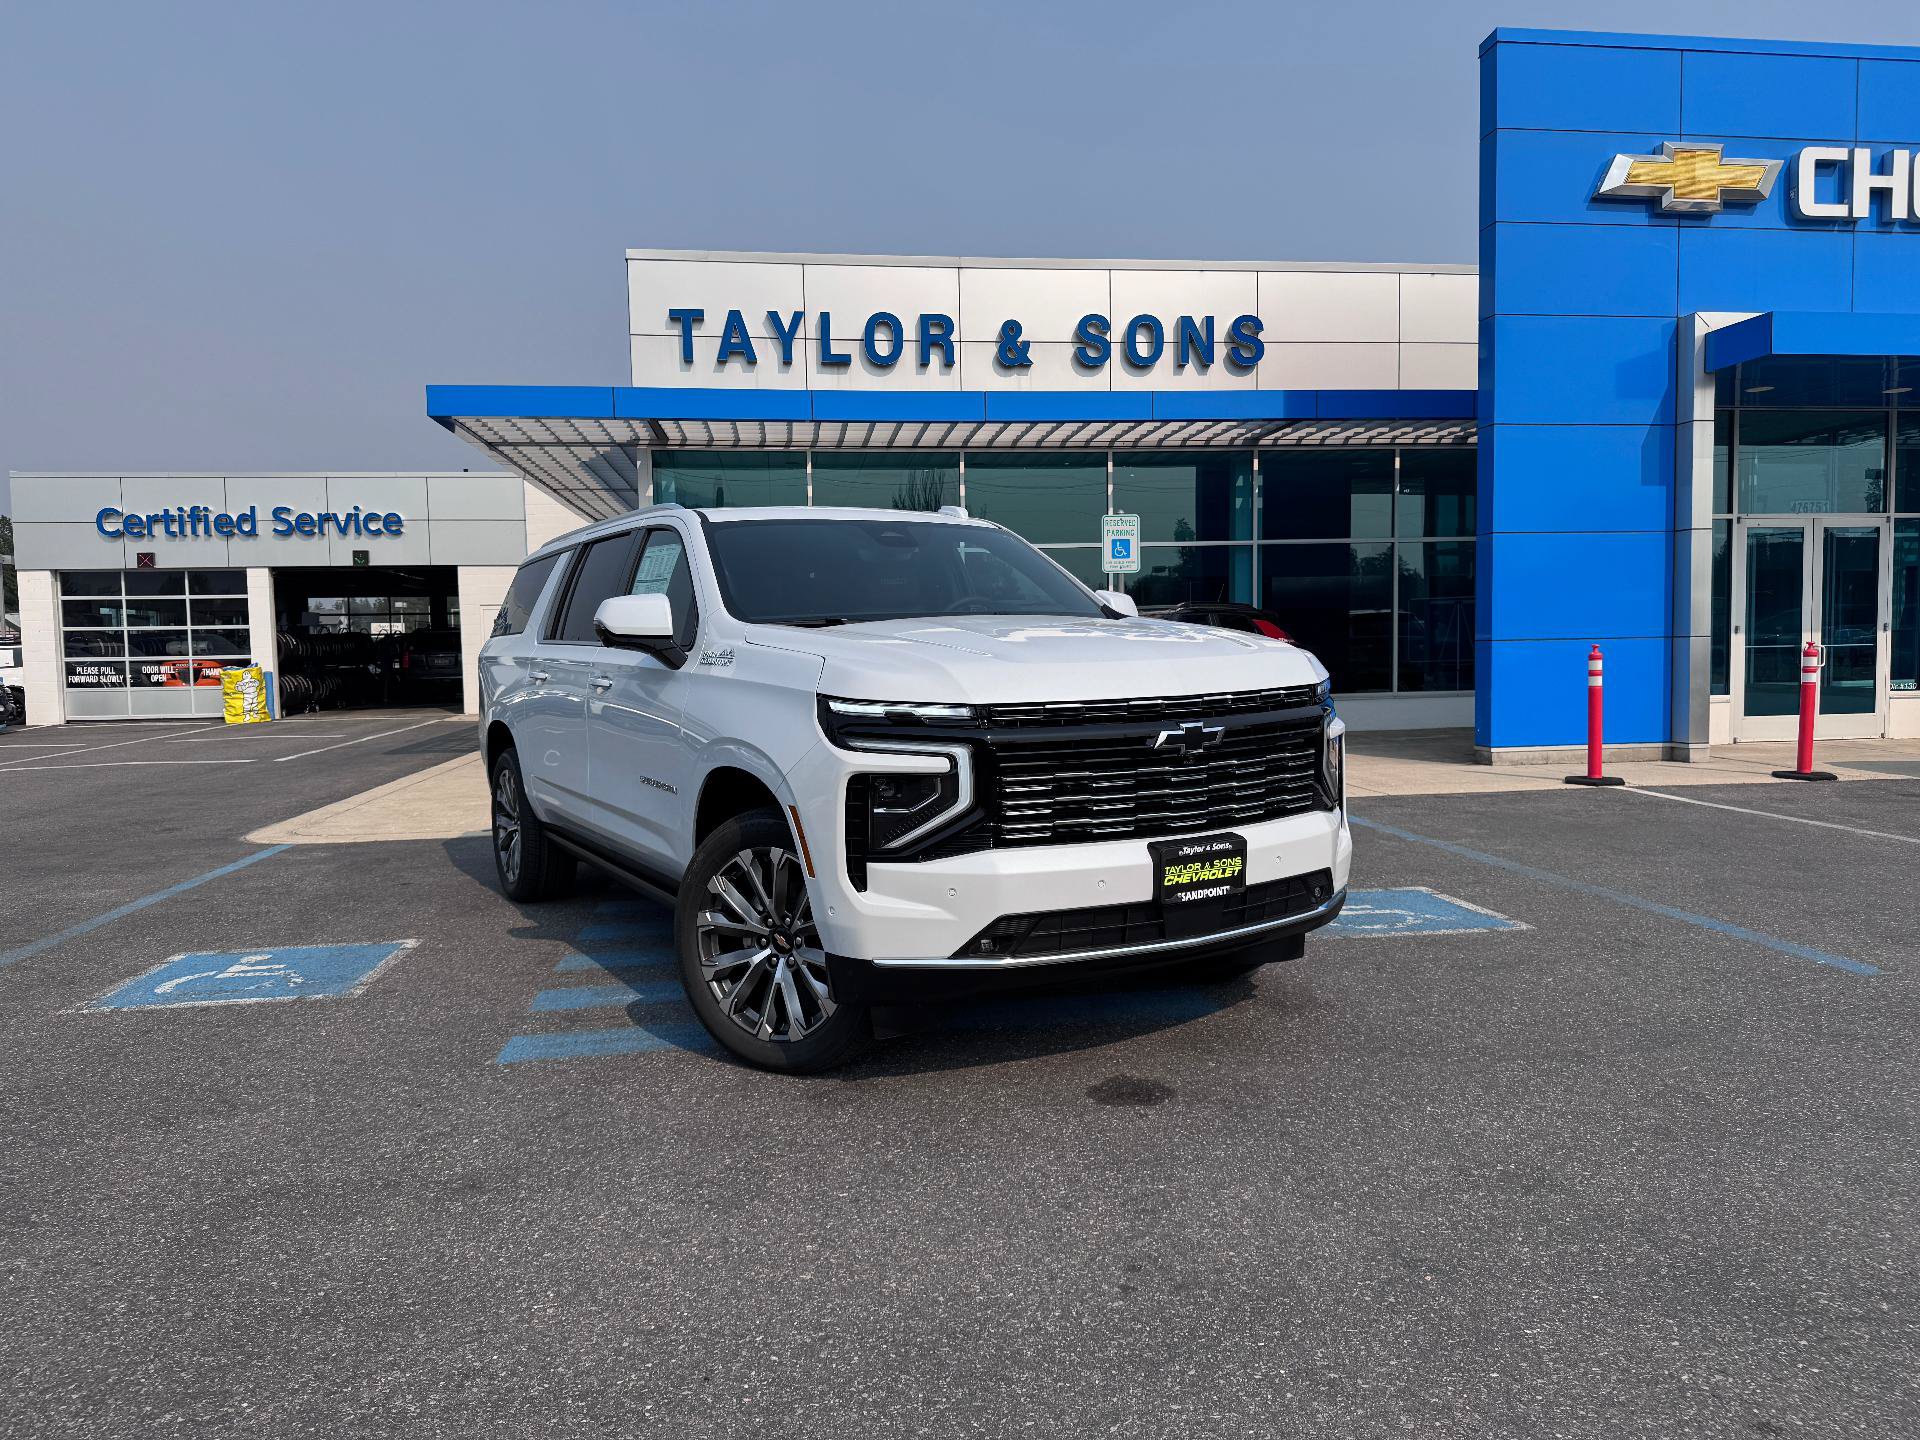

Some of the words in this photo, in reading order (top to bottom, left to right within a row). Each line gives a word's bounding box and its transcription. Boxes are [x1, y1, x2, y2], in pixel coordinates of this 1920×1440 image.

[1799, 146, 1920, 219] CH
[668, 308, 955, 366] TAYLOR
[997, 318, 1034, 366] &
[1076, 313, 1265, 367] SONS
[96, 505, 257, 537] Certified
[271, 505, 403, 536] Service
[1105, 519, 1136, 527] RESERVED
[1106, 529, 1135, 537] PARKING
[76, 666, 99, 675] PLEASE
[101, 666, 116, 675] PULL
[142, 665, 159, 674] DOOR
[160, 665, 176, 674] WILL
[68, 675, 98, 684] FORWARD
[100, 674, 124, 683] SLOWLY
[150, 673, 167, 682] OPEN
[1182, 845, 1205, 856] Taylor
[1212, 842, 1230, 851] Sons
[1165, 862, 1202, 875] TAYLOR
[1204, 861, 1211, 870] &
[1213, 857, 1242, 868] SONS
[1164, 867, 1242, 886] CHEVROLET
[1181, 885, 1229, 902] SANDPOINT
